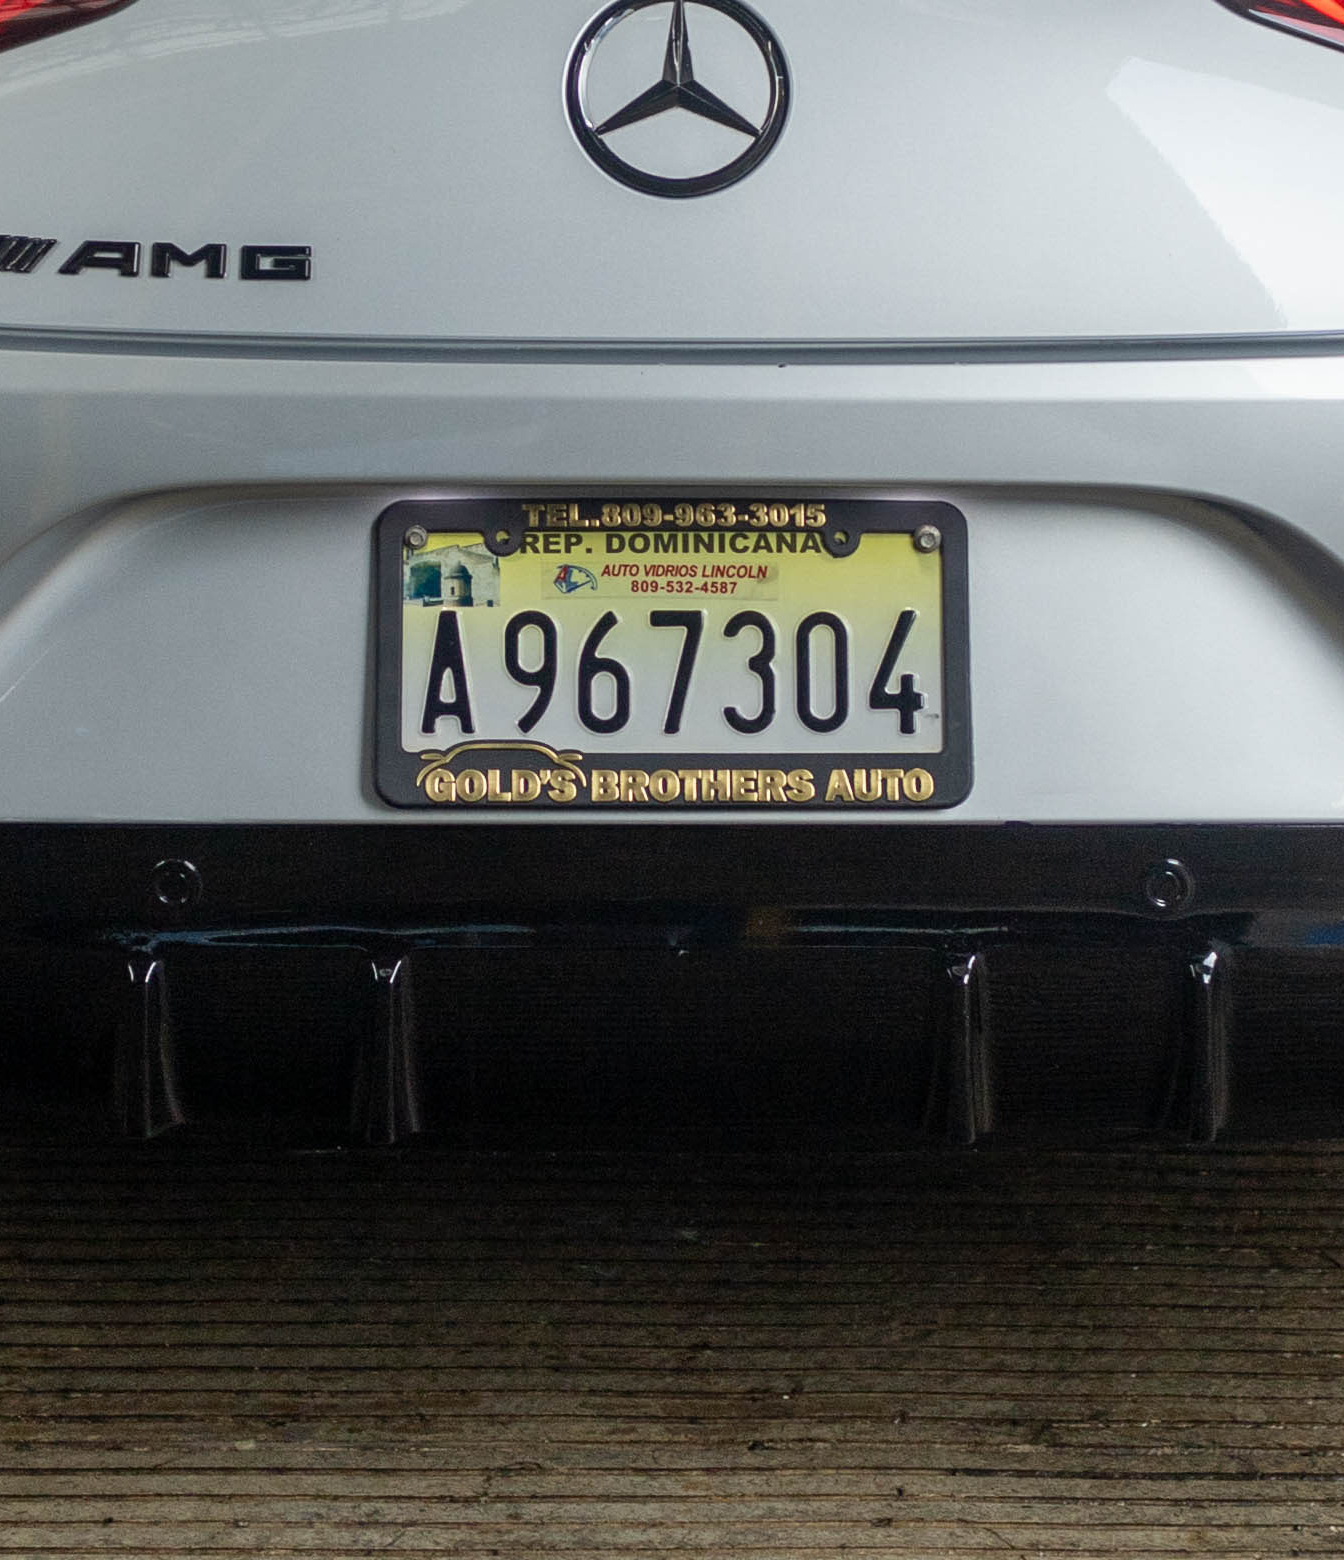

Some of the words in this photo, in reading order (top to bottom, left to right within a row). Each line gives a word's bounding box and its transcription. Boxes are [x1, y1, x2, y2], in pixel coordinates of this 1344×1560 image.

[58, 240, 313, 281] AMG
[521, 533, 593, 554] REP.
[606, 532, 823, 555] DOMINICANA
[601, 564, 640, 578] AUTO
[642, 564, 698, 579] VIDRIOS
[702, 564, 768, 580] LINCOLN
[630, 580, 737, 595] 809-532-4587
[421, 609, 926, 735] A967304
[424, 768, 579, 803] GOLD'S
[590, 768, 815, 803] BROTHERS
[825, 768, 935, 803] AUTO
